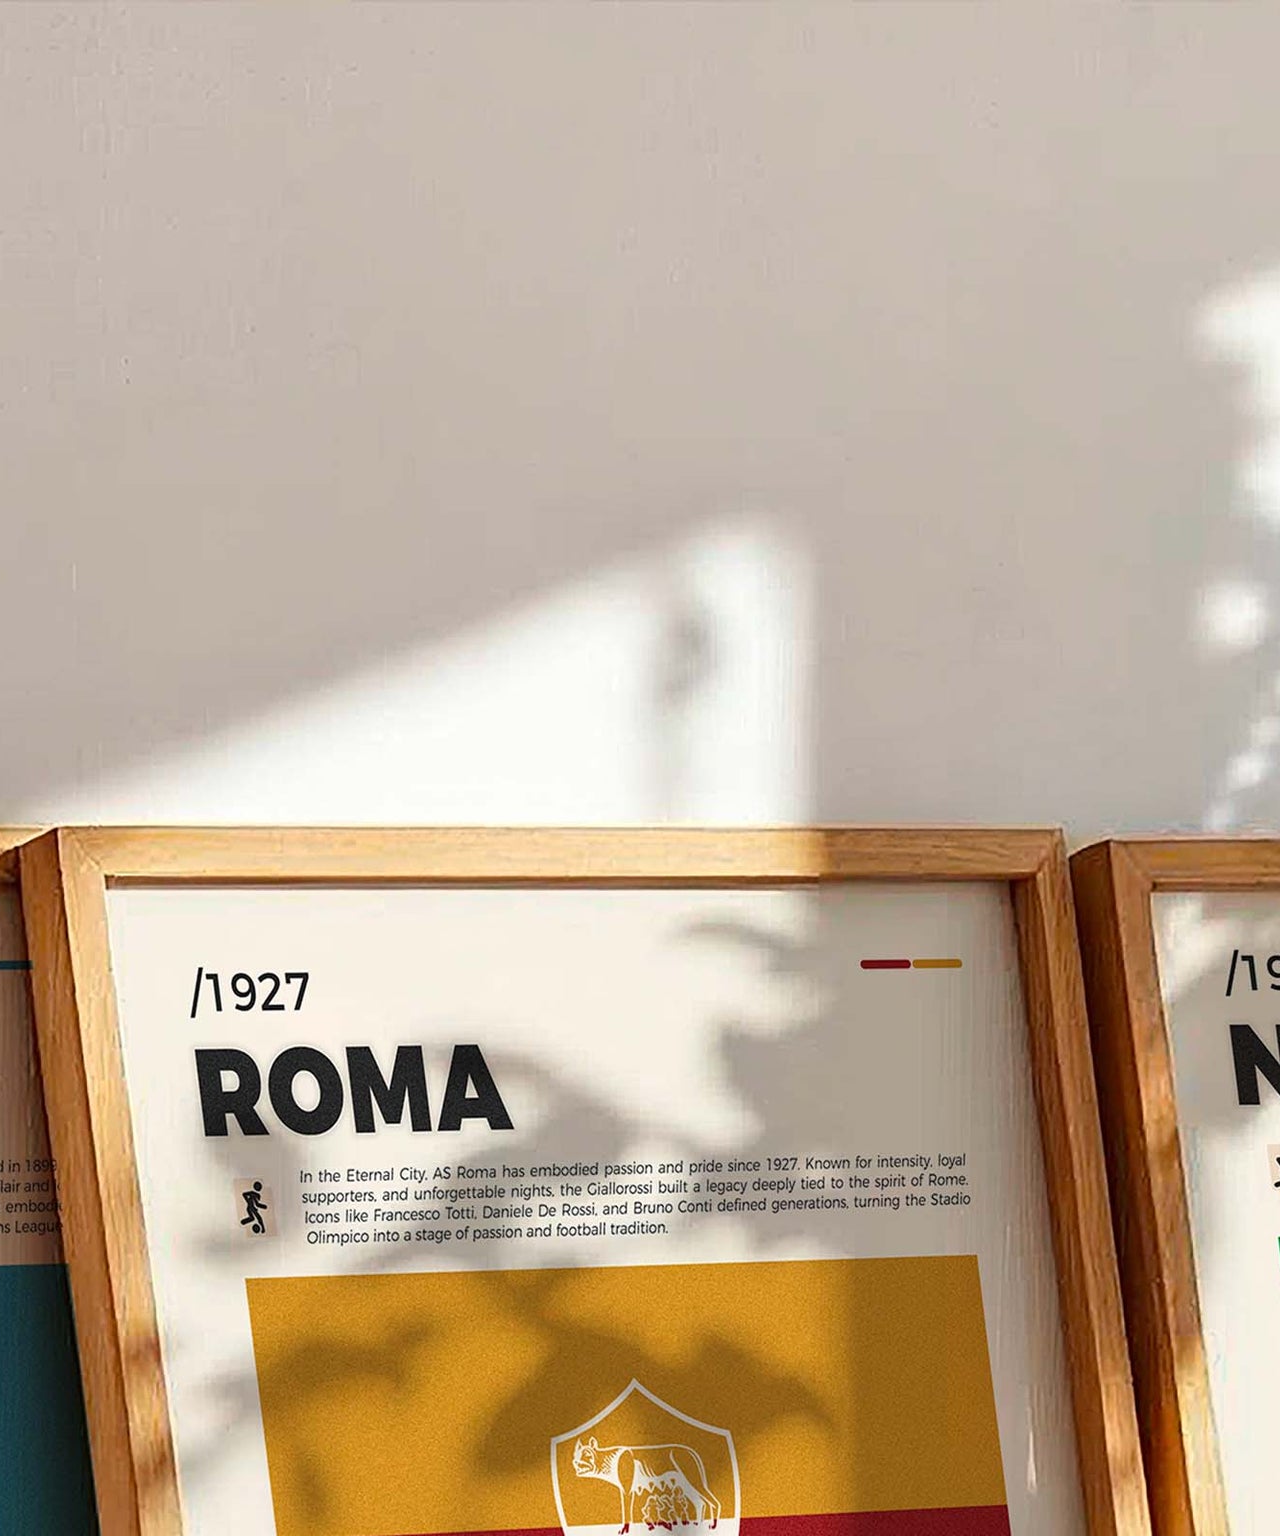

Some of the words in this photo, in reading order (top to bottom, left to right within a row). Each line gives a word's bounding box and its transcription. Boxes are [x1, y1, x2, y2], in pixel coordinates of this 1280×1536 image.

[191, 967, 308, 1018] /1927
[195, 1045, 514, 1136] ROMA
[8, 1159, 21, 1173] in
[300, 1170, 313, 1183] In
[318, 1169, 341, 1183] the
[346, 1167, 394, 1182] Eternal
[432, 1166, 451, 1180] AS
[457, 1165, 497, 1179] Roma
[502, 1164, 525, 1178] has
[529, 1162, 599, 1177] embodied
[604, 1161, 653, 1178] passion
[658, 1160, 683, 1174] and
[689, 1159, 723, 1176] pride
[727, 1158, 761, 1172] since
[766, 1157, 800, 1171] 1927.
[805, 1157, 851, 1170] Known
[855, 1155, 873, 1169] for
[937, 1153, 966, 1170] loyal
[306, 1229, 370, 1247] Olimpico
[373, 1228, 400, 1242] into
[403, 1230, 412, 1242] a
[415, 1228, 452, 1244] stage
[455, 1225, 470, 1240] of
[472, 1224, 522, 1242] passion
[526, 1223, 552, 1238] and
[556, 1221, 606, 1237] football
[610, 1220, 668, 1235] tradition.
